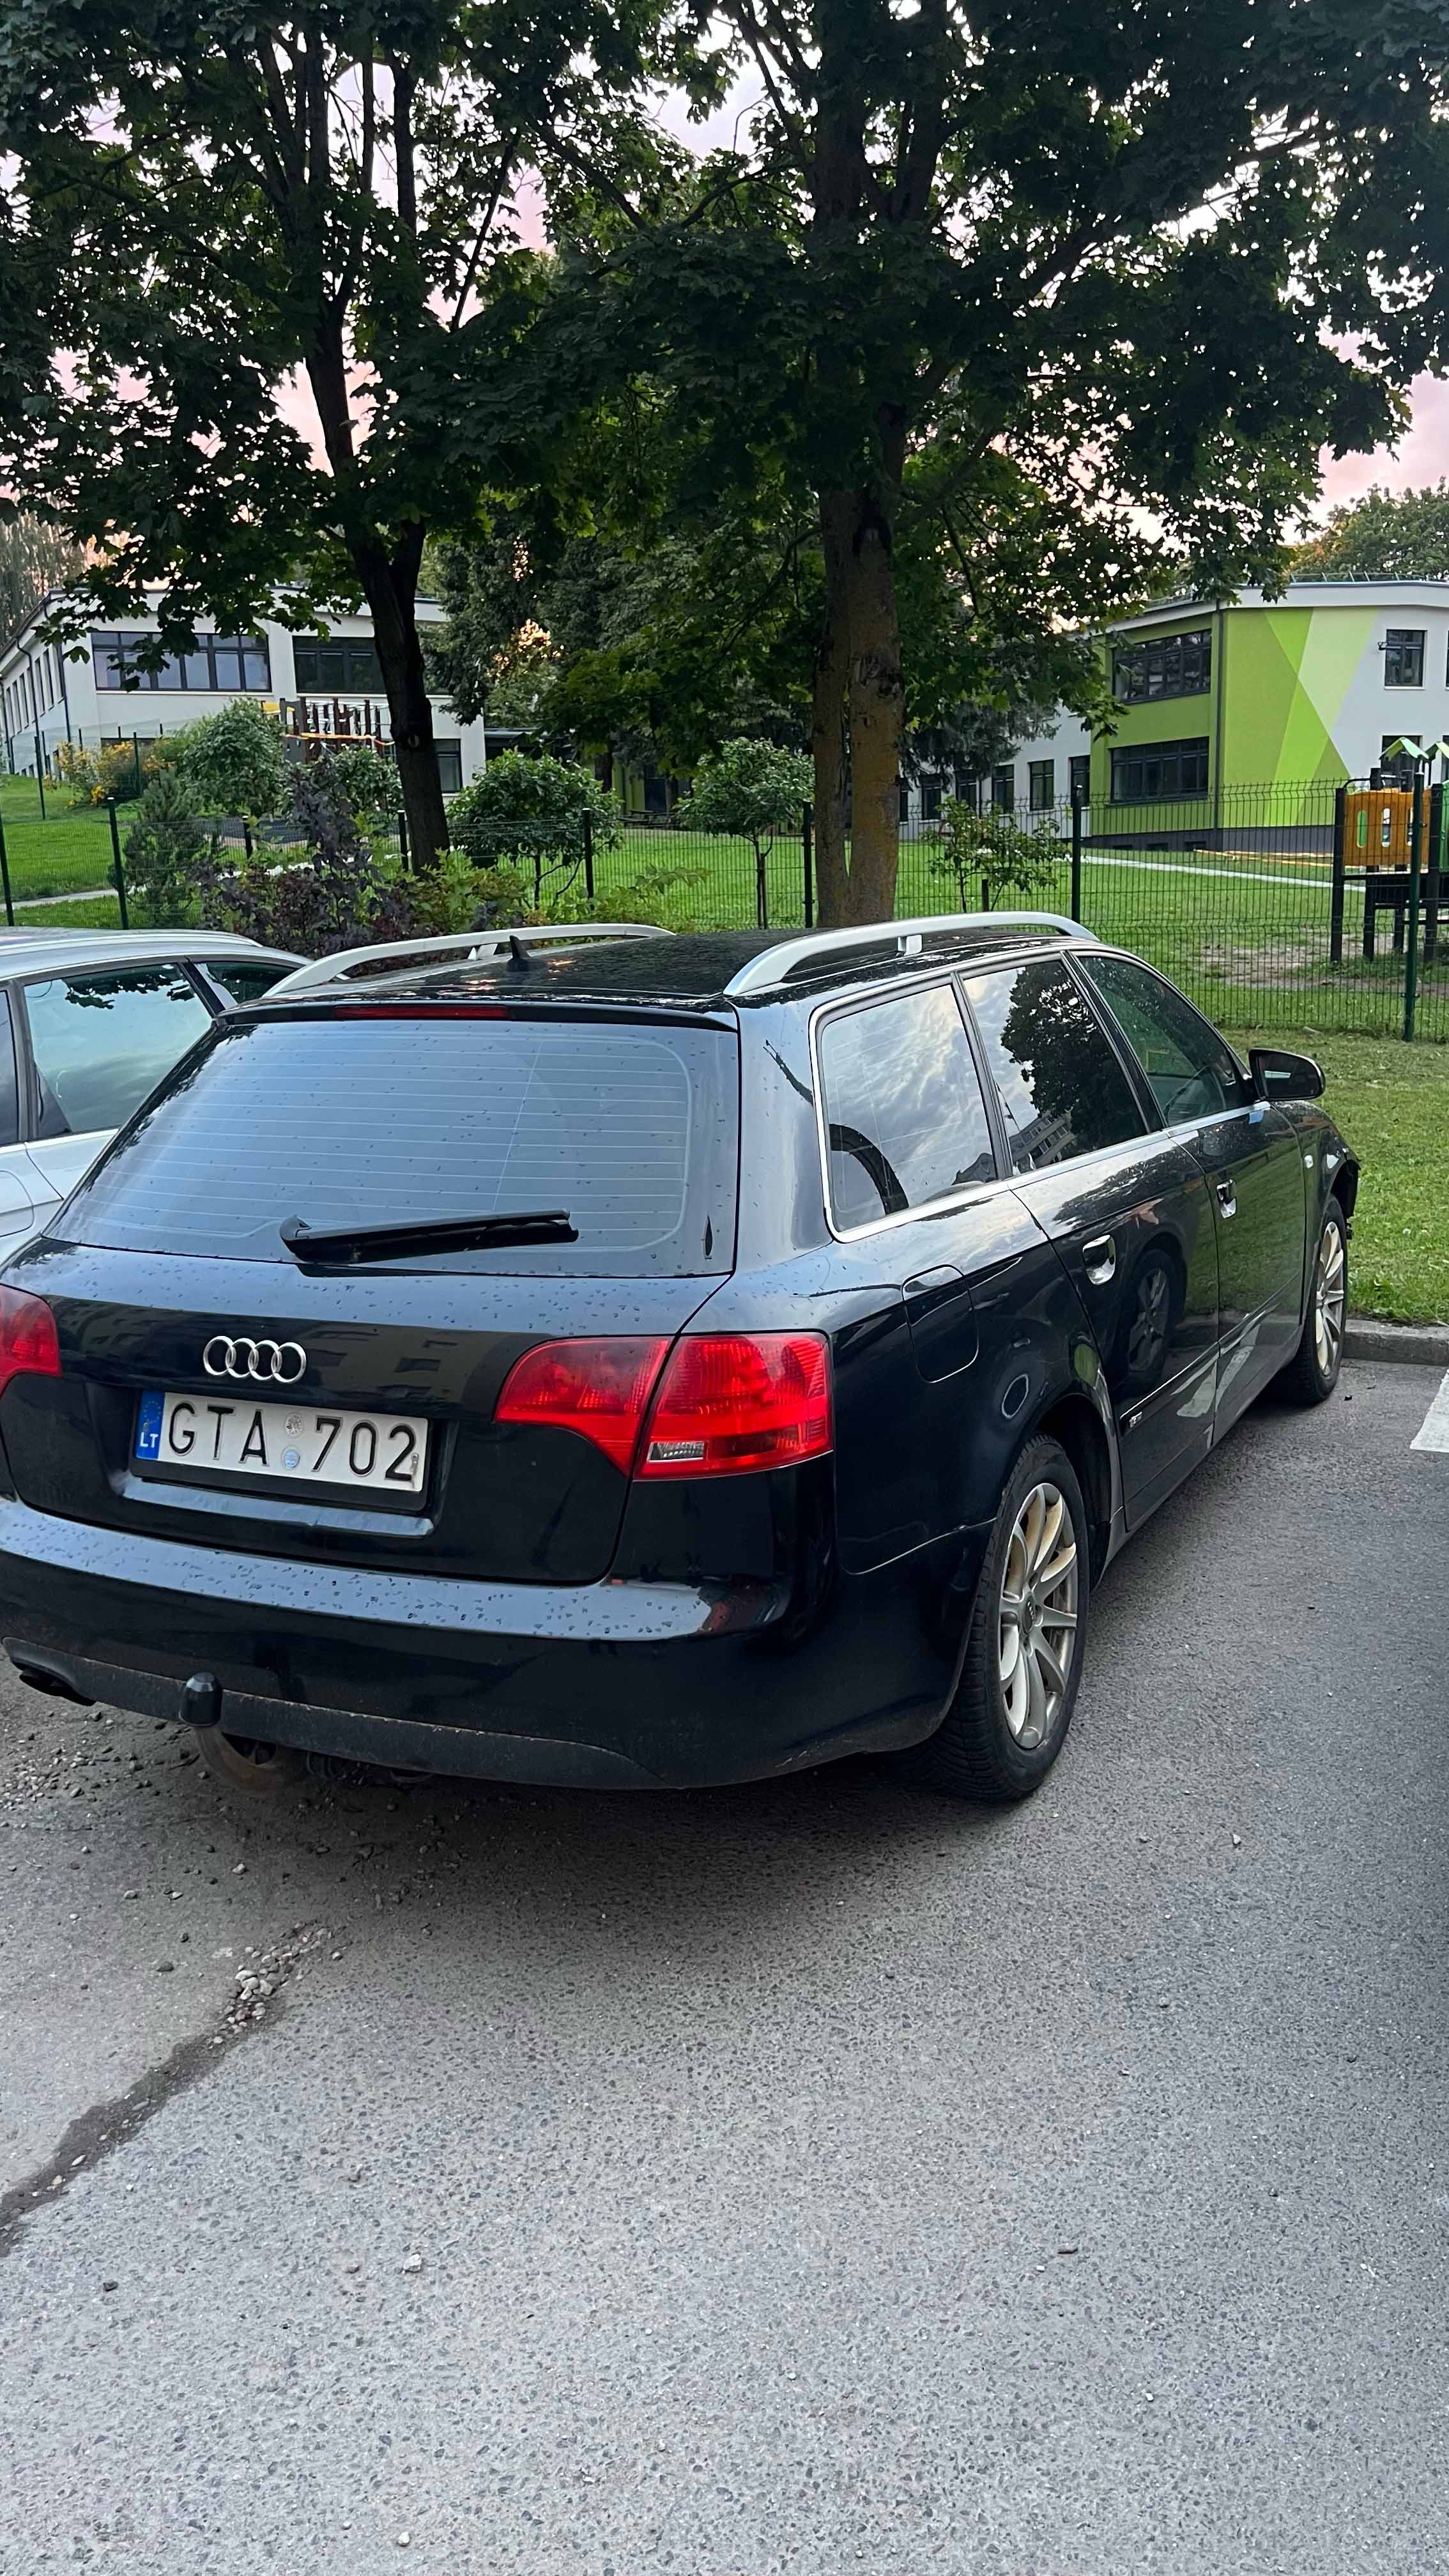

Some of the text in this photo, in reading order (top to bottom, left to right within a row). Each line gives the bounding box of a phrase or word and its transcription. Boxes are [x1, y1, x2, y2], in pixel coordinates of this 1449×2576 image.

[140, 1432, 159, 1448] LT
[168, 1402, 417, 1482] GTA 702
